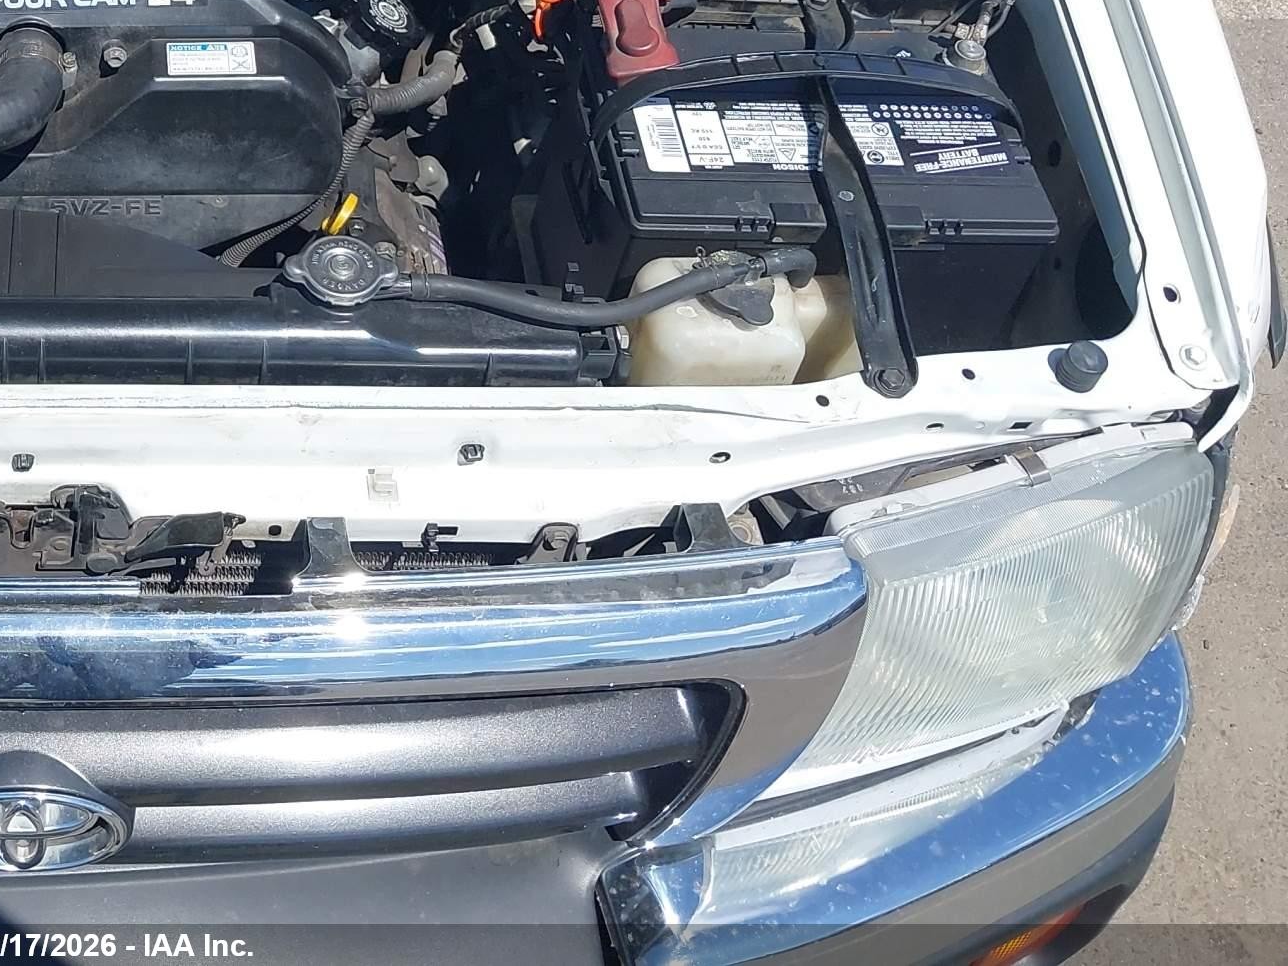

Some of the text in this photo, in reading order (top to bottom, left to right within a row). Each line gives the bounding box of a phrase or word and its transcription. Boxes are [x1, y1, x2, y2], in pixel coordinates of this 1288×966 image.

[914, 151, 1008, 172] MAINTENANCE-FREE
[936, 147, 979, 162] BATTERY
[50, 198, 162, 216] 5VZ-FE
